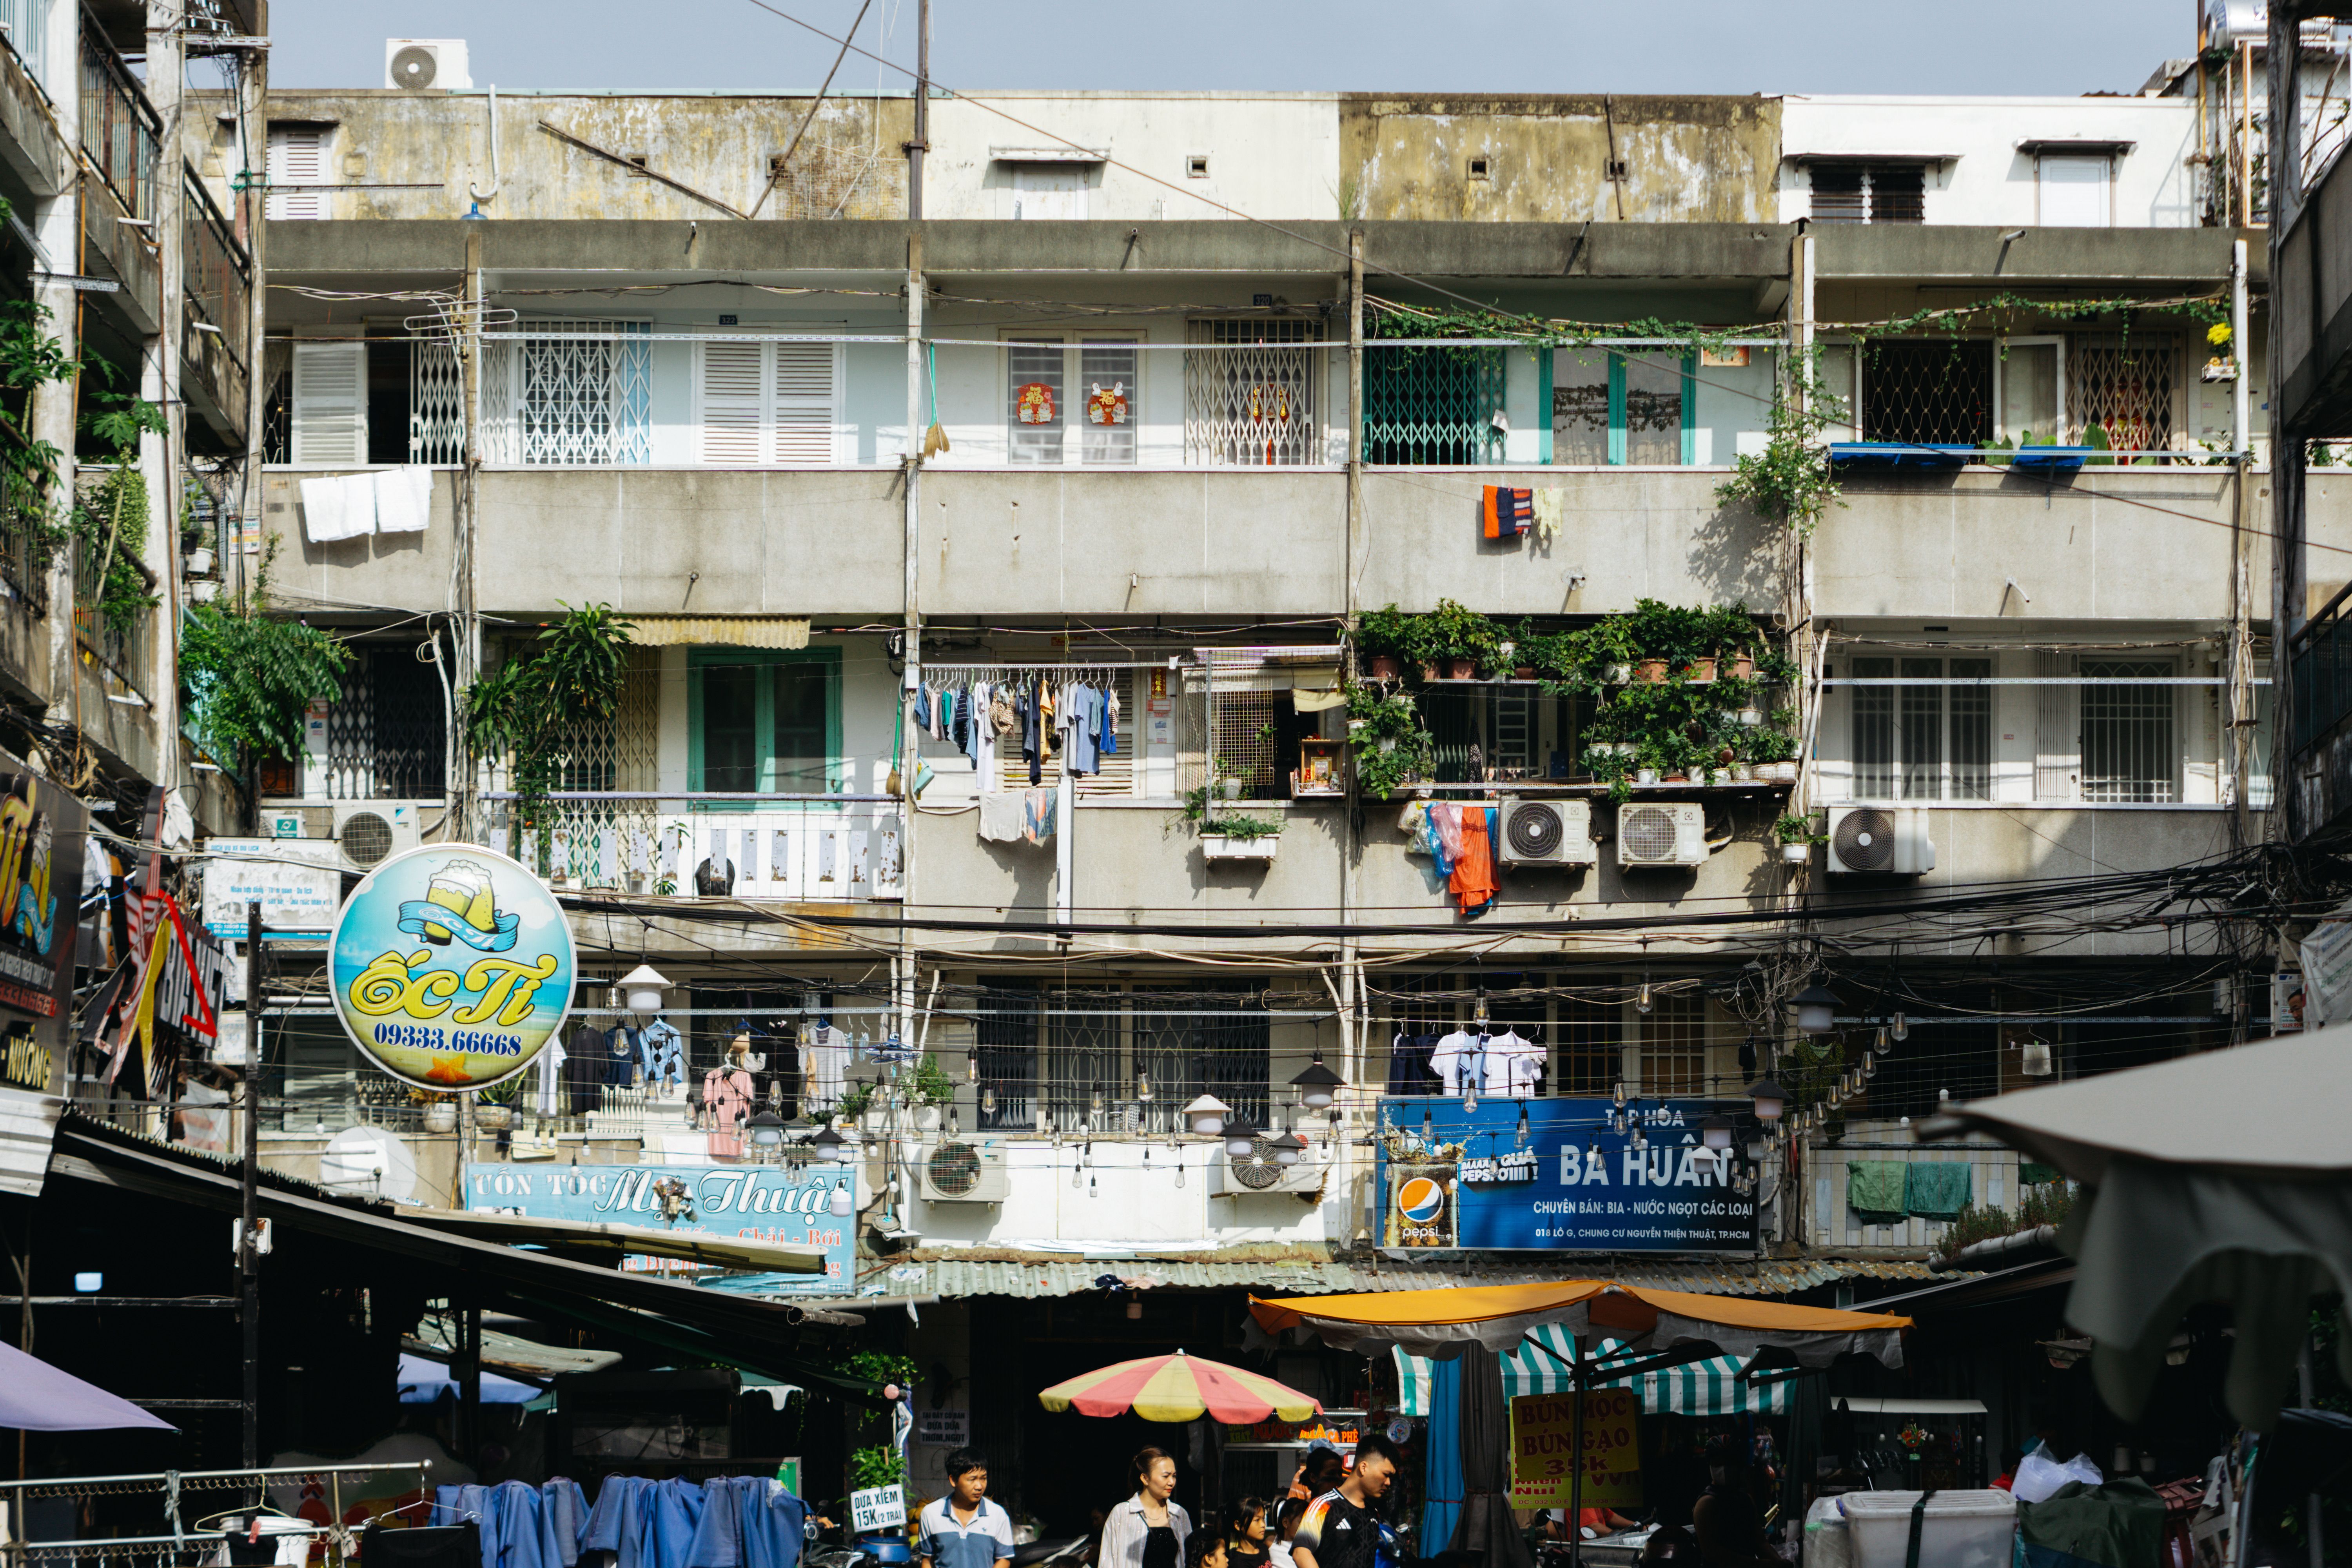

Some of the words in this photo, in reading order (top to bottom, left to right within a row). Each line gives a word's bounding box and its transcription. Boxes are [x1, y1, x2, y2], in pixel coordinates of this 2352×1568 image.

[1256, 296, 1270, 305] 320
[1025, 387, 1044, 405] 福
[1099, 391, 1115, 405] 福
[1566, 853, 1581, 861] R32
[374, 1022, 522, 1057] 09333.66668
[1605, 1109, 1639, 1126] TP
[1500, 1145, 1538, 1167] QUÁ
[1622, 1133, 1728, 1187] HUÂN
[472, 1166, 533, 1195] UỐN
[546, 1169, 606, 1195] TÓC
[1534, 1198, 1576, 1214] CHUYÊN
[1579, 1198, 1604, 1214] BÁN:
[1607, 1202, 1624, 1214] BIA
[1633, 1199, 1665, 1215] NƯỚC
[1668, 1202, 1698, 1218] NGỌT
[1701, 1200, 1725, 1216] CÁC
[1729, 1203, 1753, 1219] LOẠI
[807, 1228, 842, 1246] Bới
[1402, 1225, 1439, 1240] pepsi
[1535, 1229, 1551, 1238] 018
[1553, 1227, 1564, 1237] LÔ
[1578, 1229, 1610, 1237] CHUNG
[1612, 1228, 1625, 1238] CƯ
[1627, 1227, 1661, 1238] NGUYỄN
[1663, 1229, 1686, 1240] THIỆN
[1689, 1229, 1717, 1240] THUẬT,
[1719, 1230, 1749, 1239] TP.HCM
[1520, 1397, 1570, 1425] BÚN
[1581, 1396, 1627, 1423] MỌC
[1341, 1428, 1359, 1443] PHÊ
[1522, 1428, 1572, 1456] BÚN
[1582, 1427, 1630, 1453] GẠO
[855, 1493, 872, 1509] DỪA
[875, 1489, 898, 1505] XIÊM
[886, 1508, 902, 1521] TRÁI
